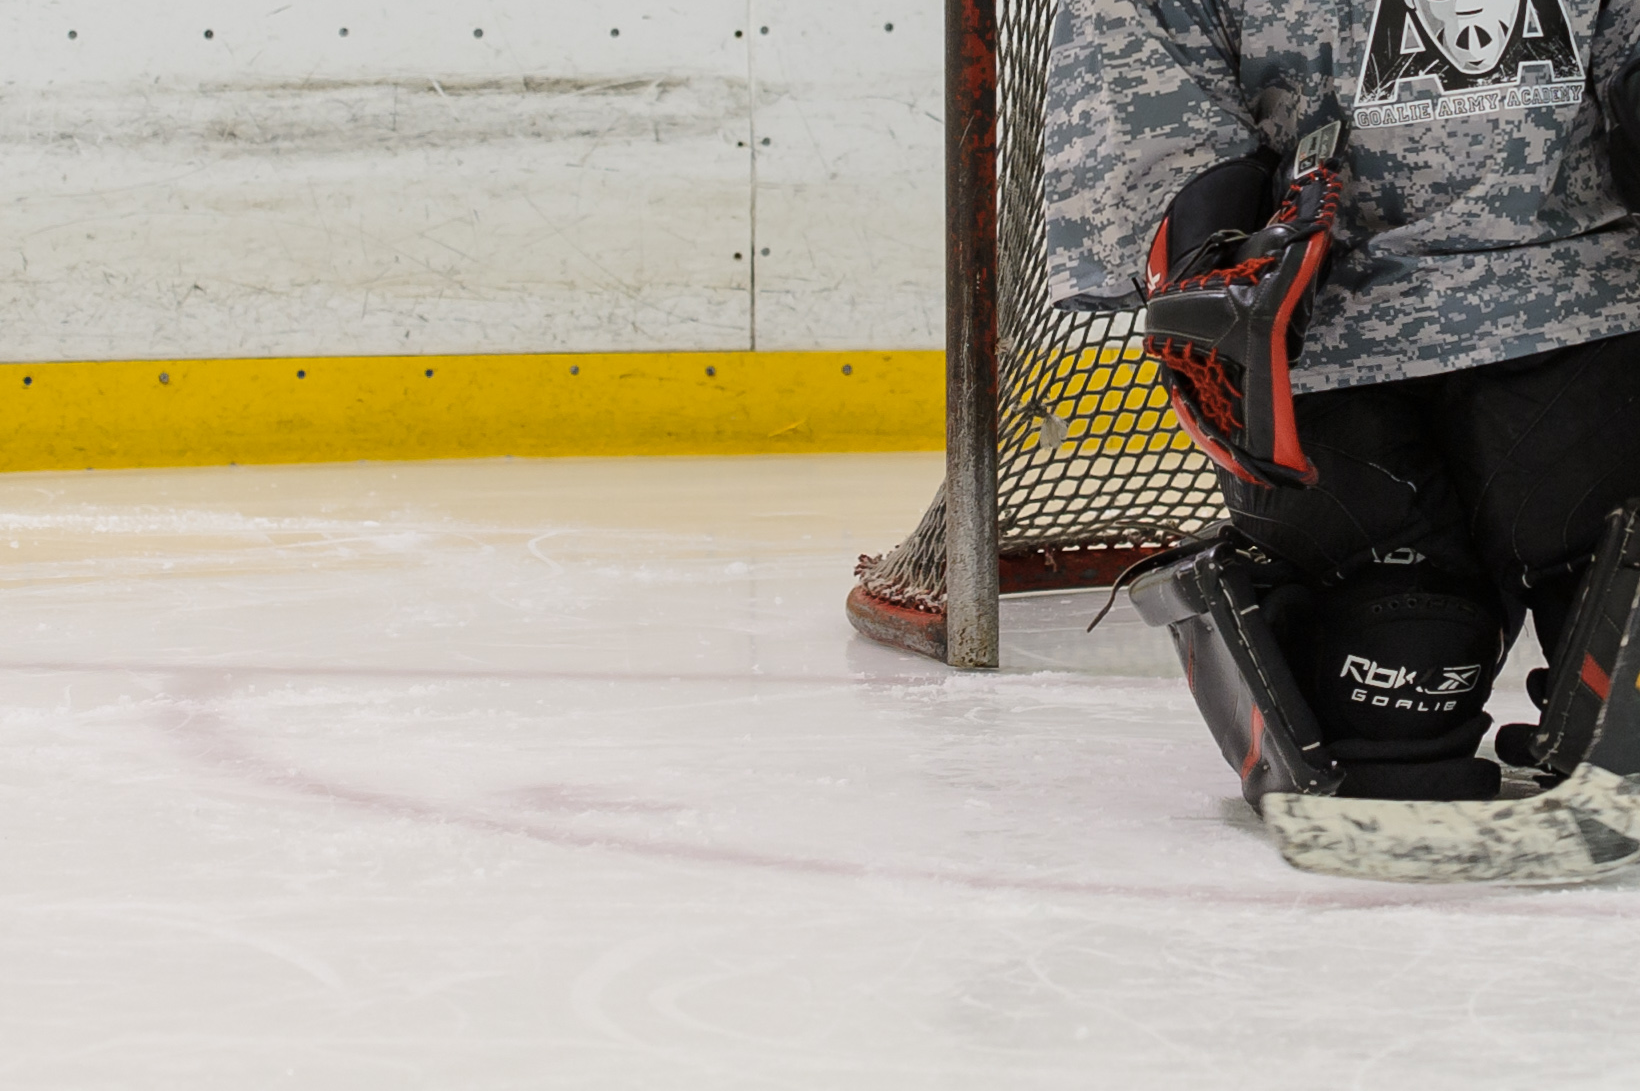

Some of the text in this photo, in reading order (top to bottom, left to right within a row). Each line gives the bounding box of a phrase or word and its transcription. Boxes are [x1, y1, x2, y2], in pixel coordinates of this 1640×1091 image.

[1356, 84, 1585, 128] GOALIE ARMY ACADEMY
[1351, 688, 1458, 712] GOALIE
